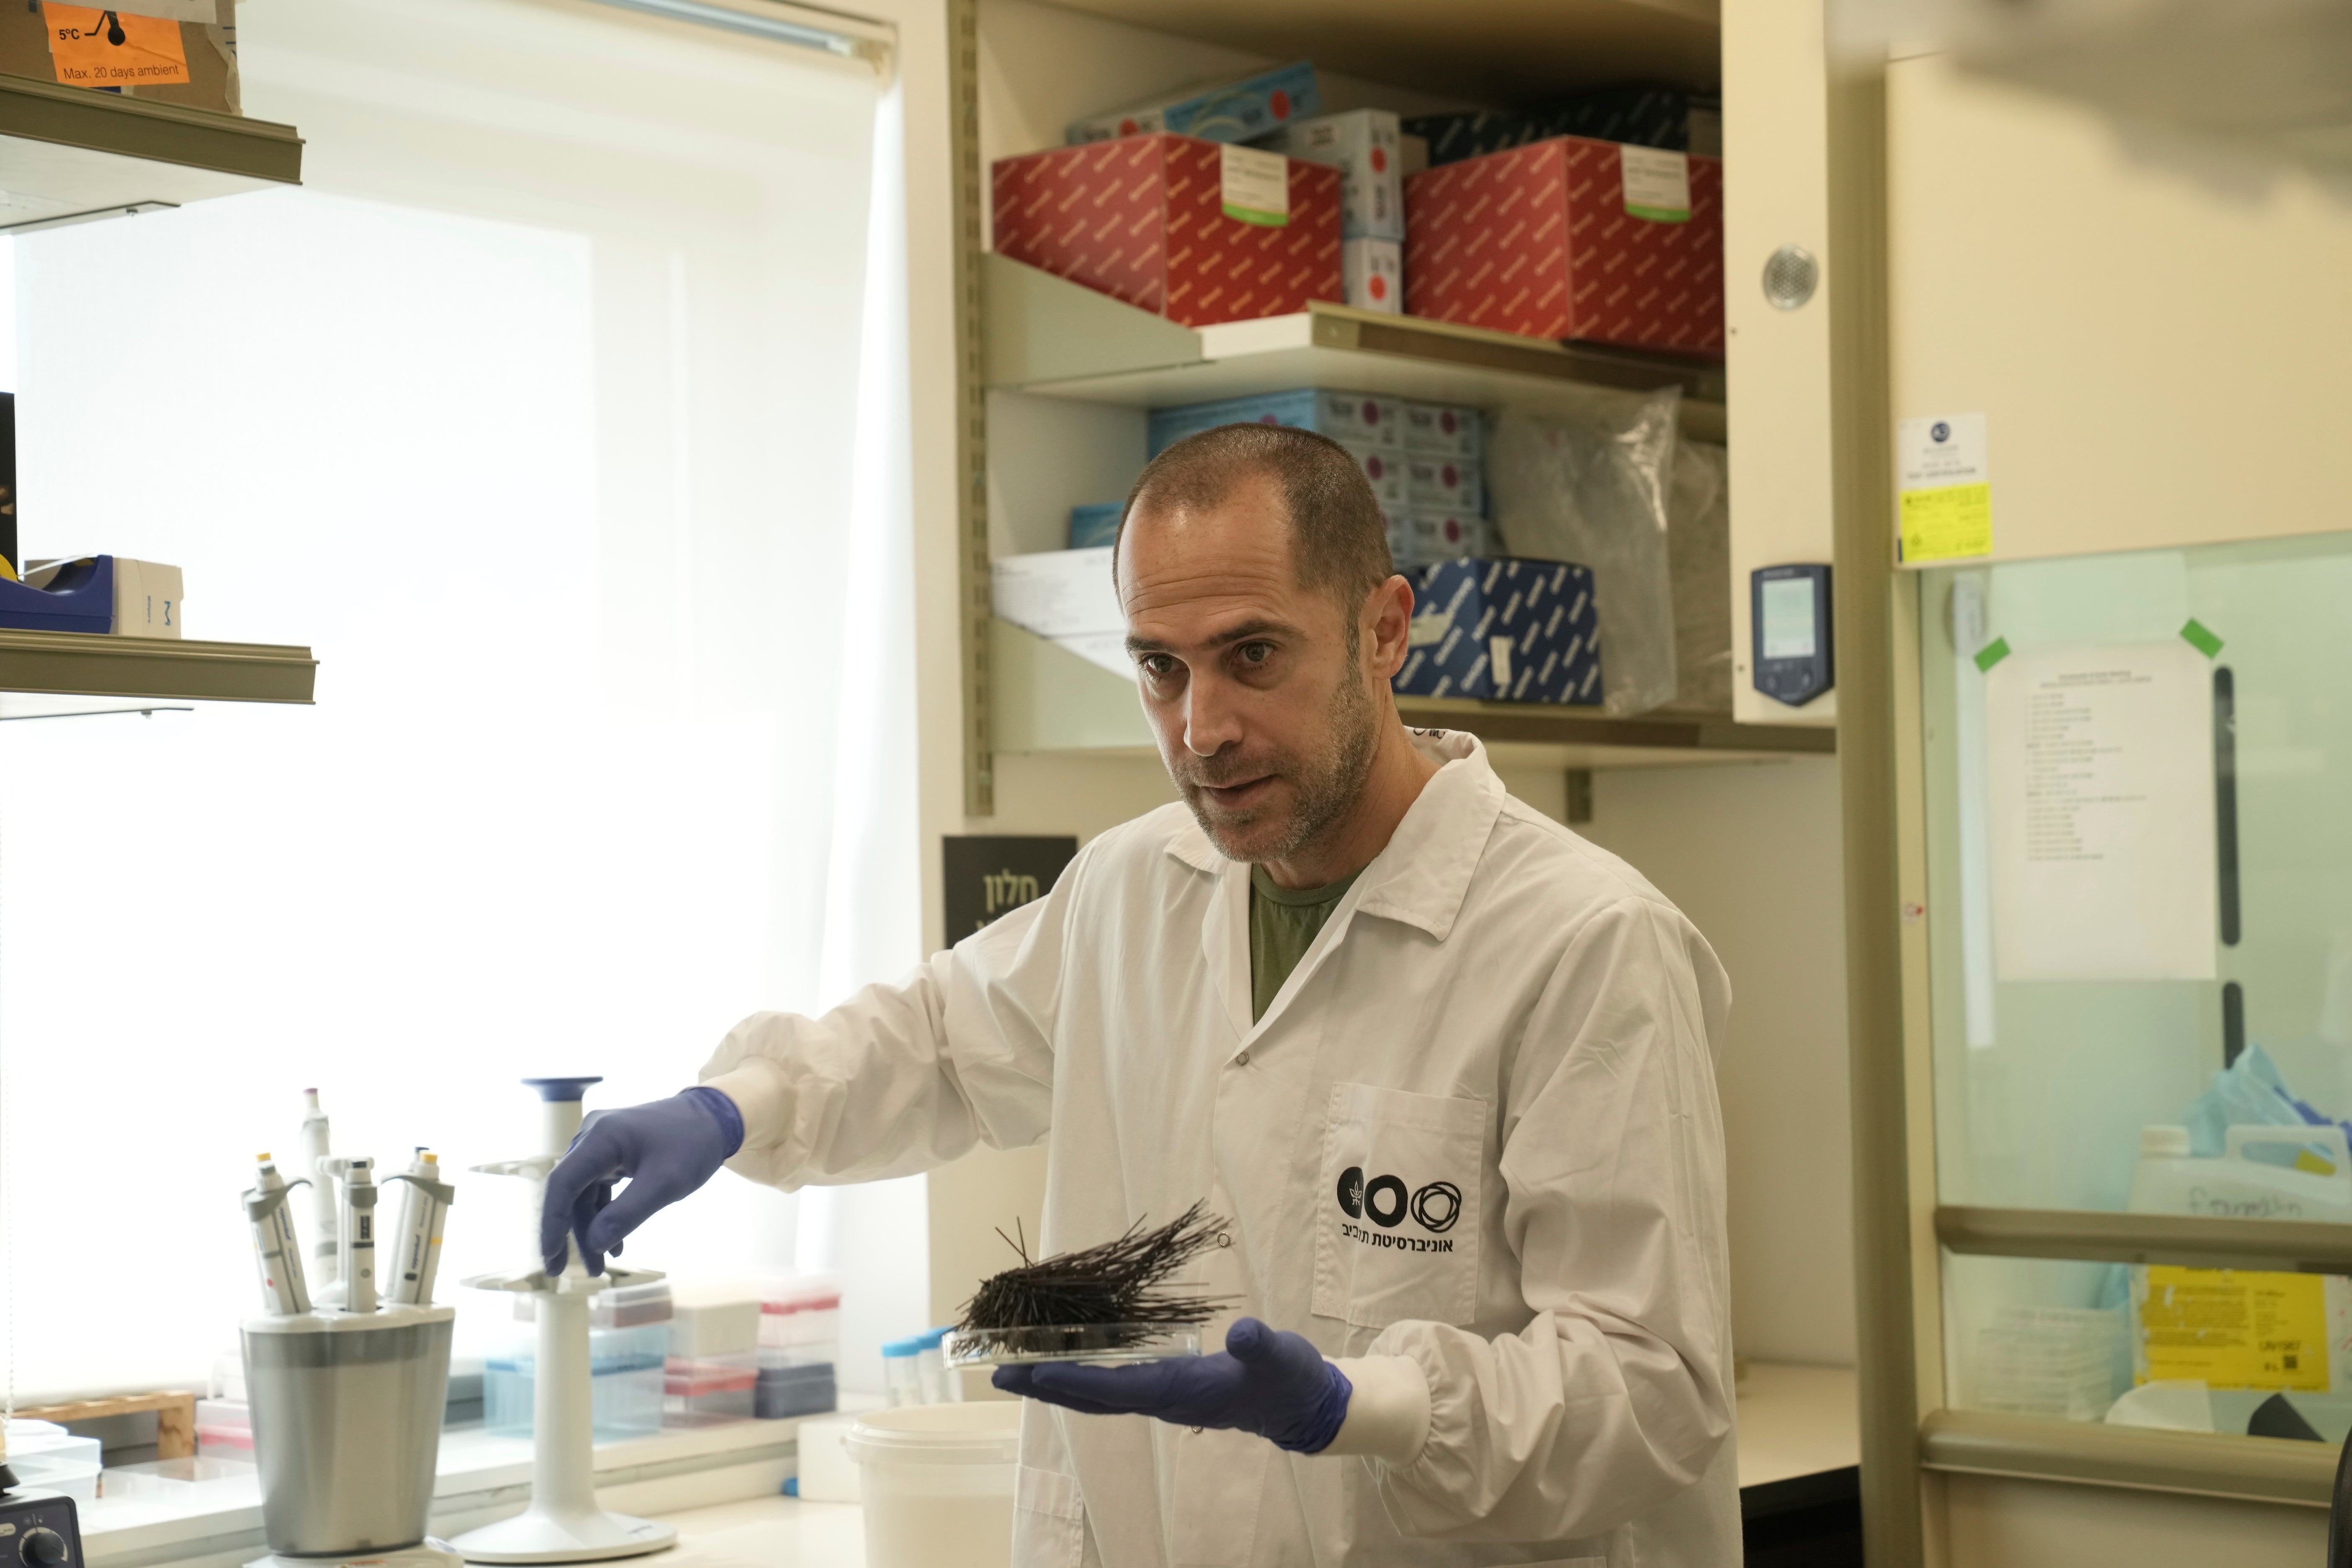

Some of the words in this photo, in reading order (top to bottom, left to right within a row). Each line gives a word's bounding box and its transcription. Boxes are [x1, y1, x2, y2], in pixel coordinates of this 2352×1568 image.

[64, 68, 91, 80] Max.
[93, 67, 107, 78] 20
[110, 66, 135, 80] days
[137, 64, 179, 77] ambient
[984, 868, 1039, 914] חלון
[1371, 1233, 1453, 1252] אוניברסיטת
